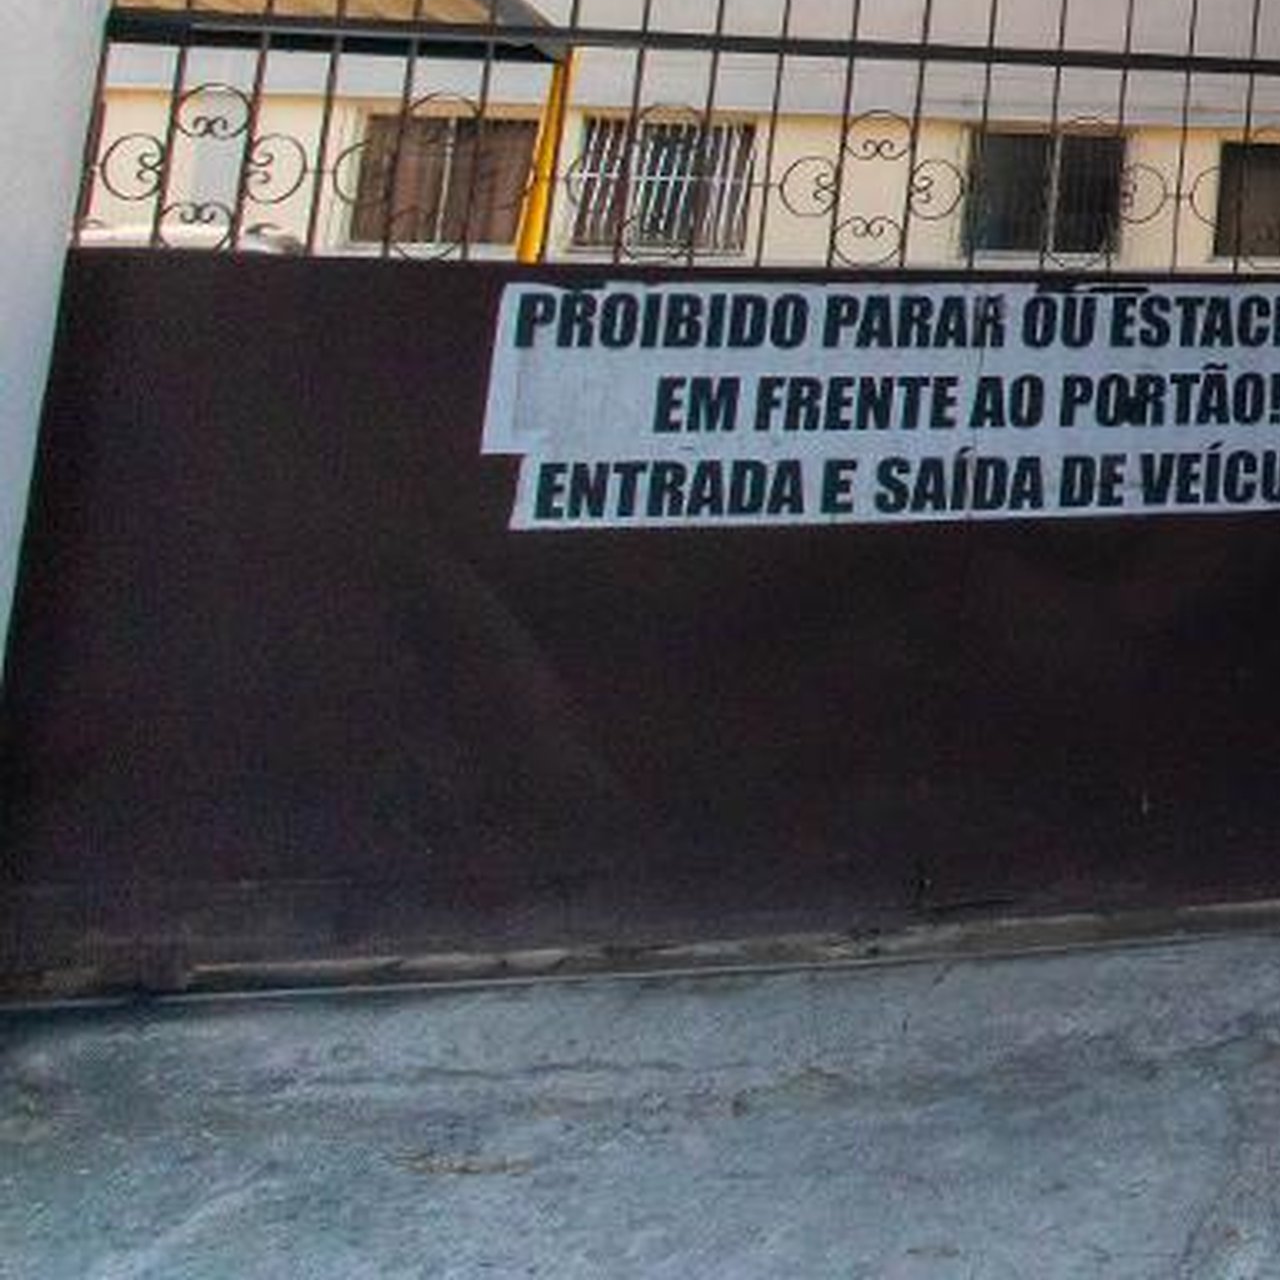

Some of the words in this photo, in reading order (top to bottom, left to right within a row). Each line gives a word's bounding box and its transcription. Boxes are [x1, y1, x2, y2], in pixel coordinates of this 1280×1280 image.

[514, 293, 809, 349] PROIBIDO
[823, 294, 1005, 348] PARAR
[1022, 296, 1098, 348] OU
[653, 376, 741, 433] EM
[754, 375, 960, 431] FRENTE
[969, 373, 1045, 428] AO
[534, 459, 804, 519] ENTRADA
[820, 458, 858, 514] E
[874, 445, 1045, 514] SAÍDA
[1059, 453, 1127, 508] DE
